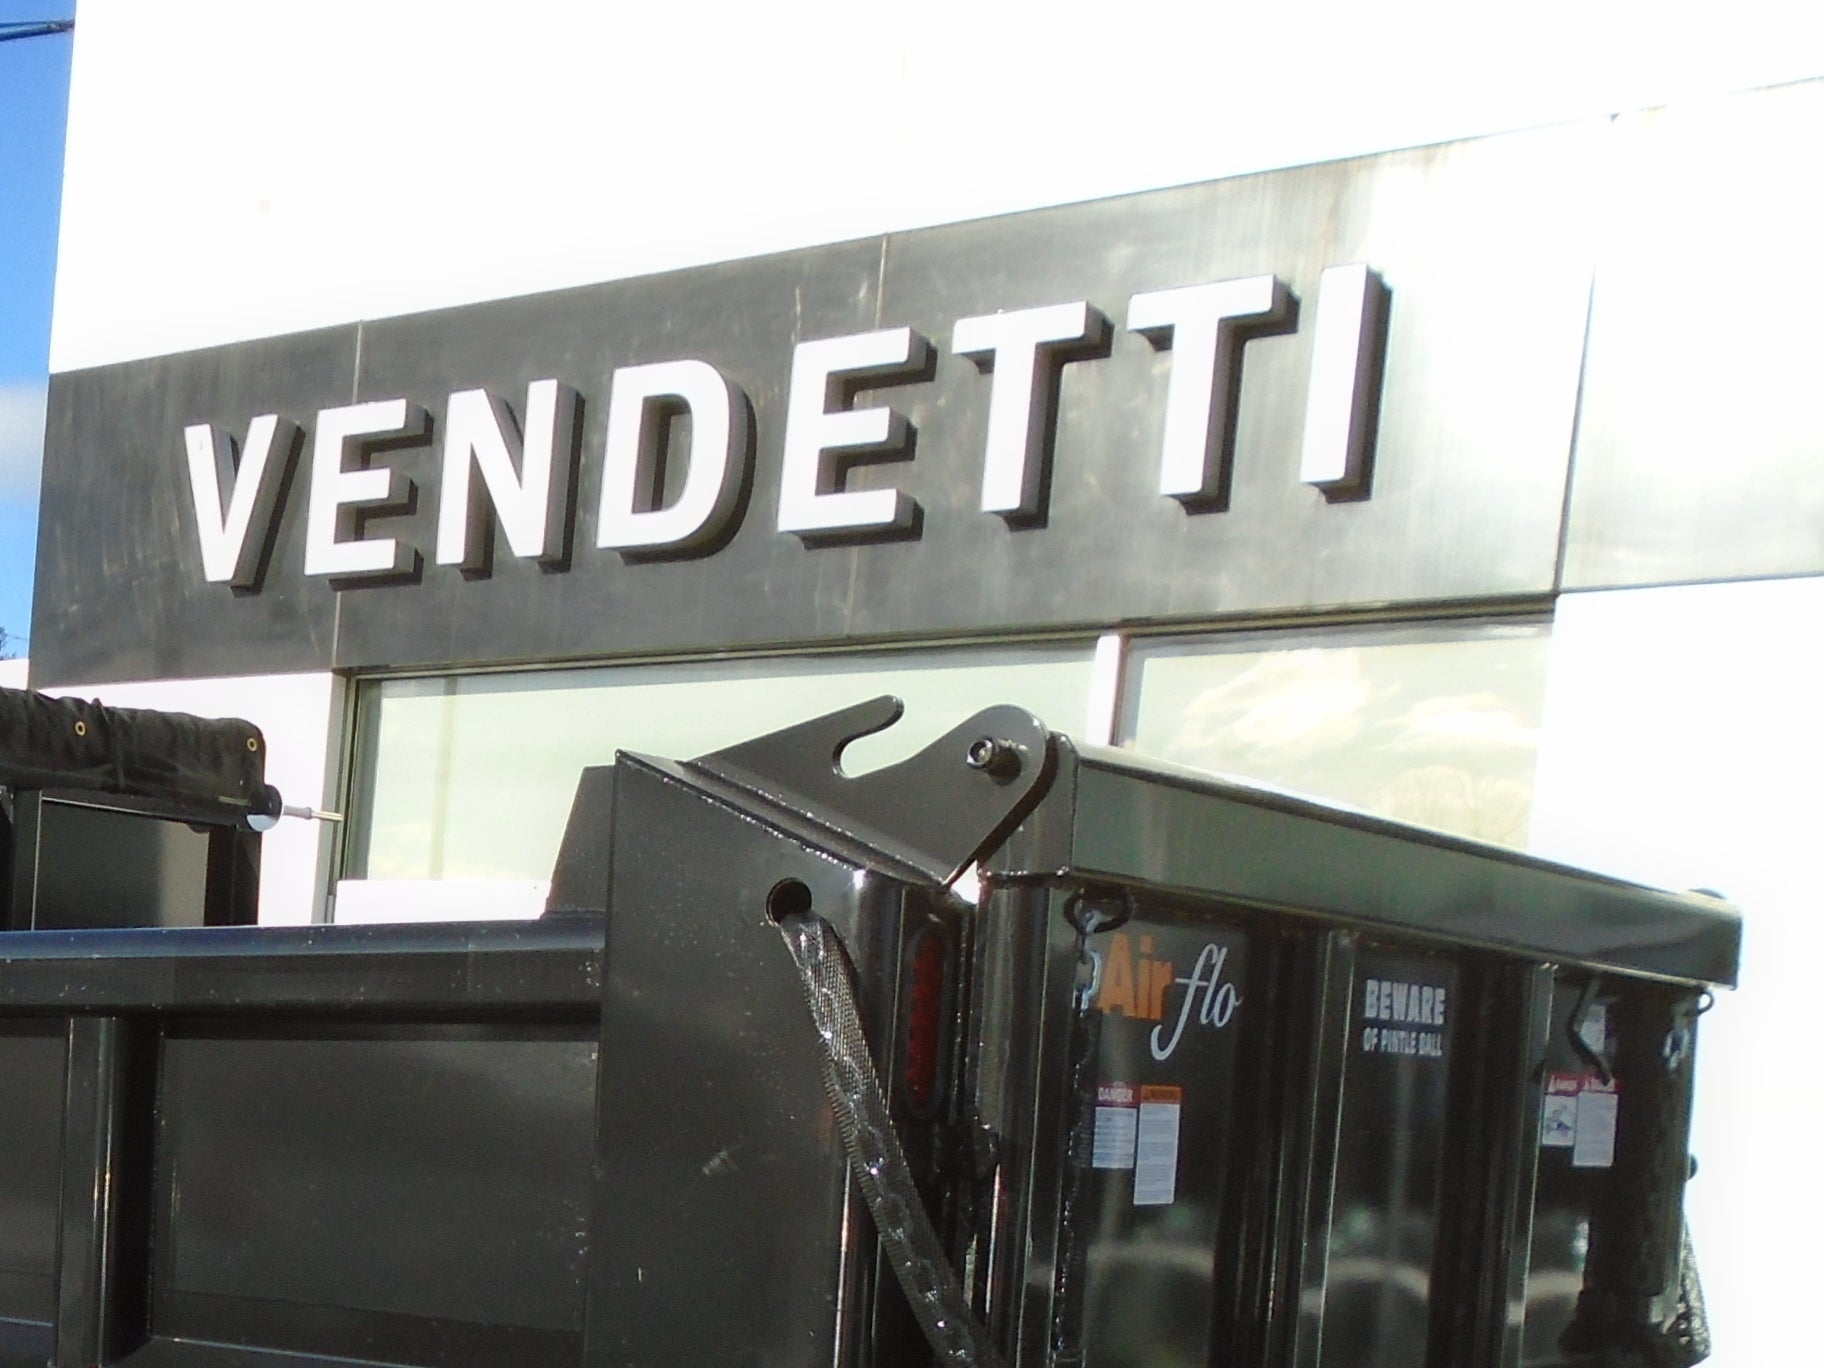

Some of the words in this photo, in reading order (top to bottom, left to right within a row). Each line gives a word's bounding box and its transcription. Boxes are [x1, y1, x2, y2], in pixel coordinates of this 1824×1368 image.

[183, 263, 1388, 590] VENDETTI
[1097, 932, 1174, 1020] Air
[1150, 943, 1244, 1061] flo
[1364, 979, 1446, 1025] BEWARE
[1363, 1026, 1379, 1051] OF
[1380, 1028, 1417, 1054] PINTLE
[1098, 1086, 1133, 1102] DANGER
